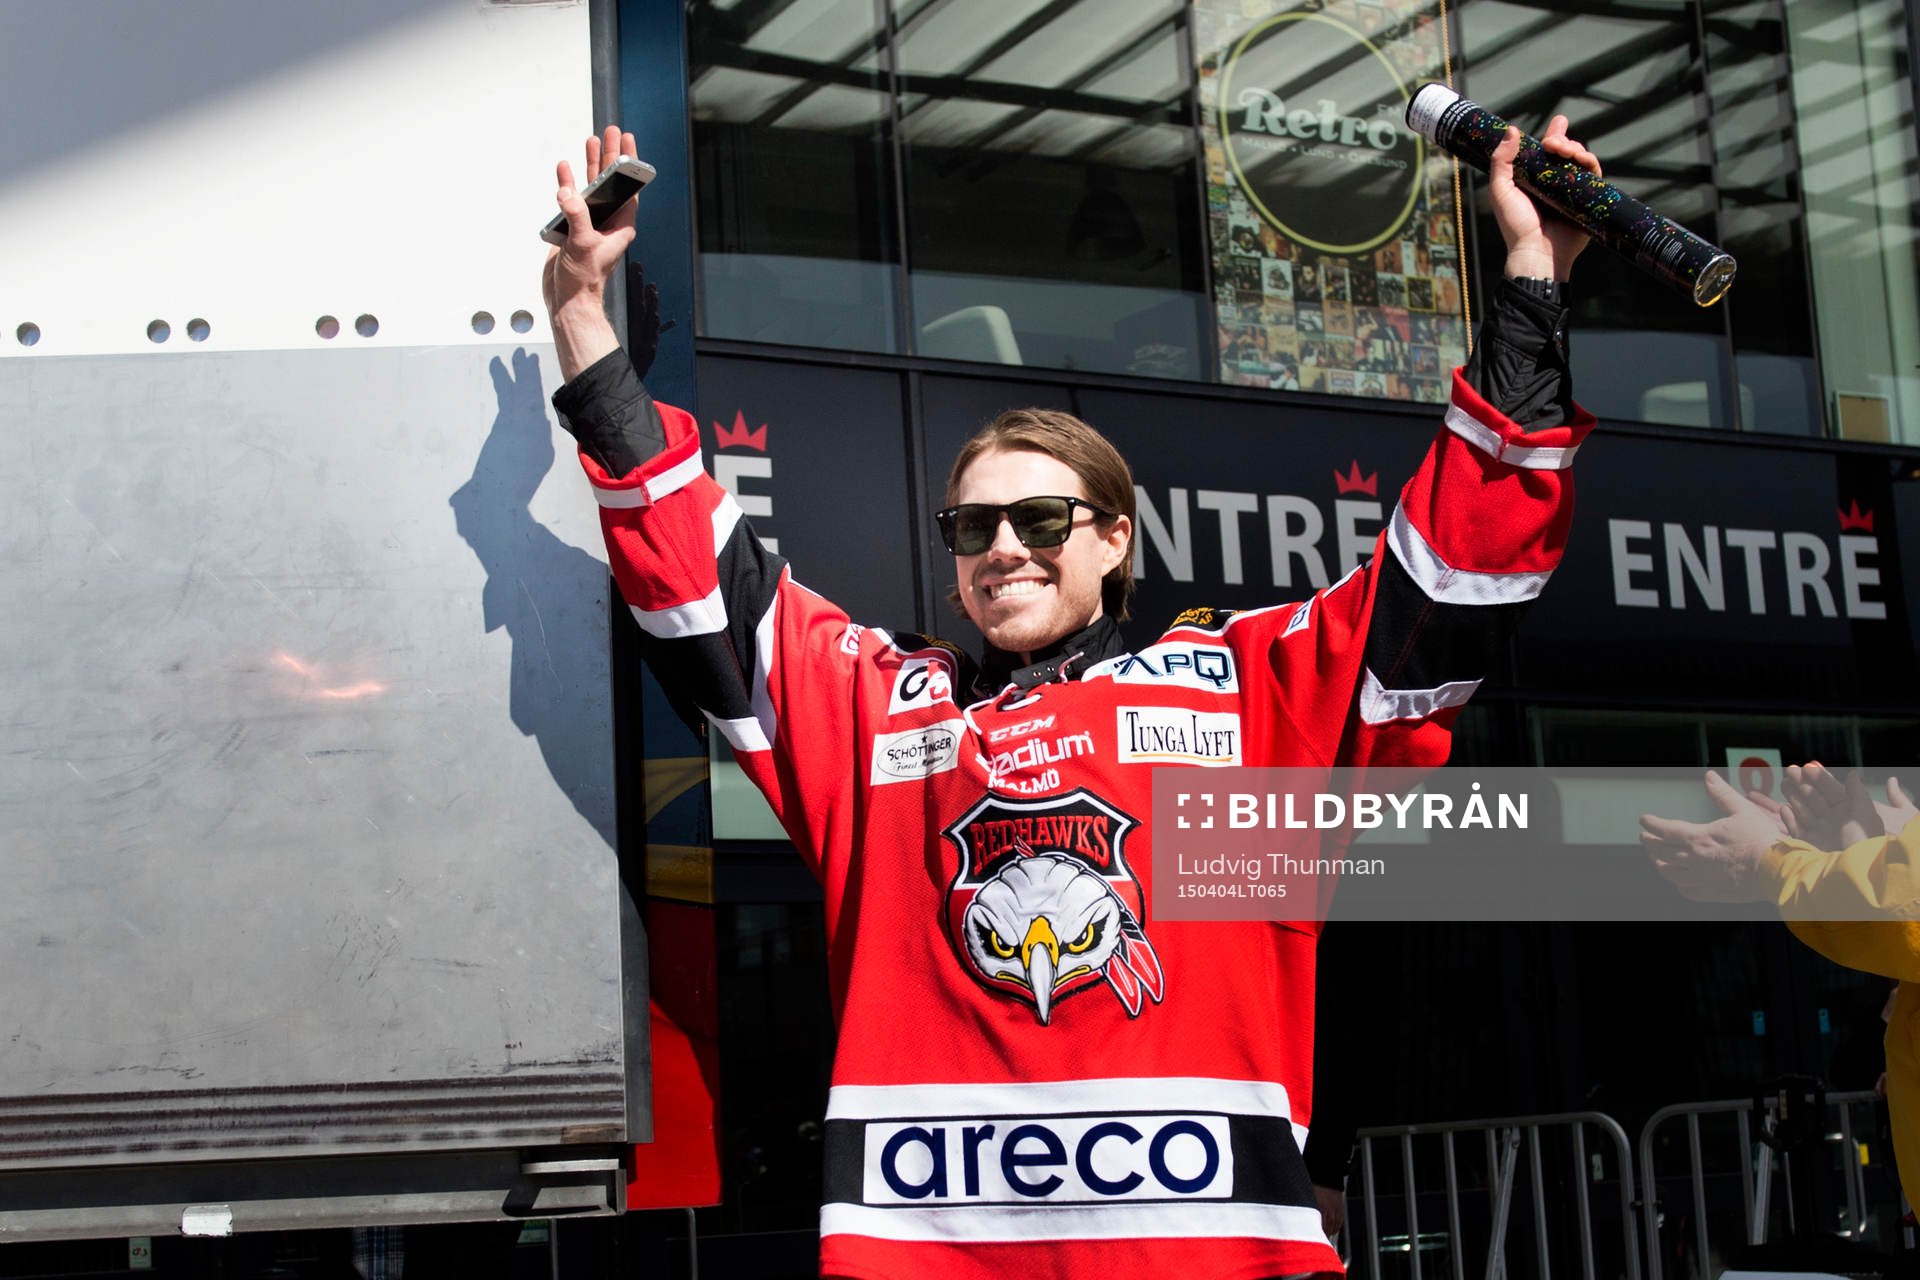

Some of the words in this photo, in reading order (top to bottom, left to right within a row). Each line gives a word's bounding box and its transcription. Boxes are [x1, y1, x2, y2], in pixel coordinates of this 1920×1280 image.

[1239, 87, 1398, 150] Retro
[989, 716, 1056, 744] CCM
[969, 815, 1111, 877] REDHAWKS
[880, 1119, 1220, 1200] areco
